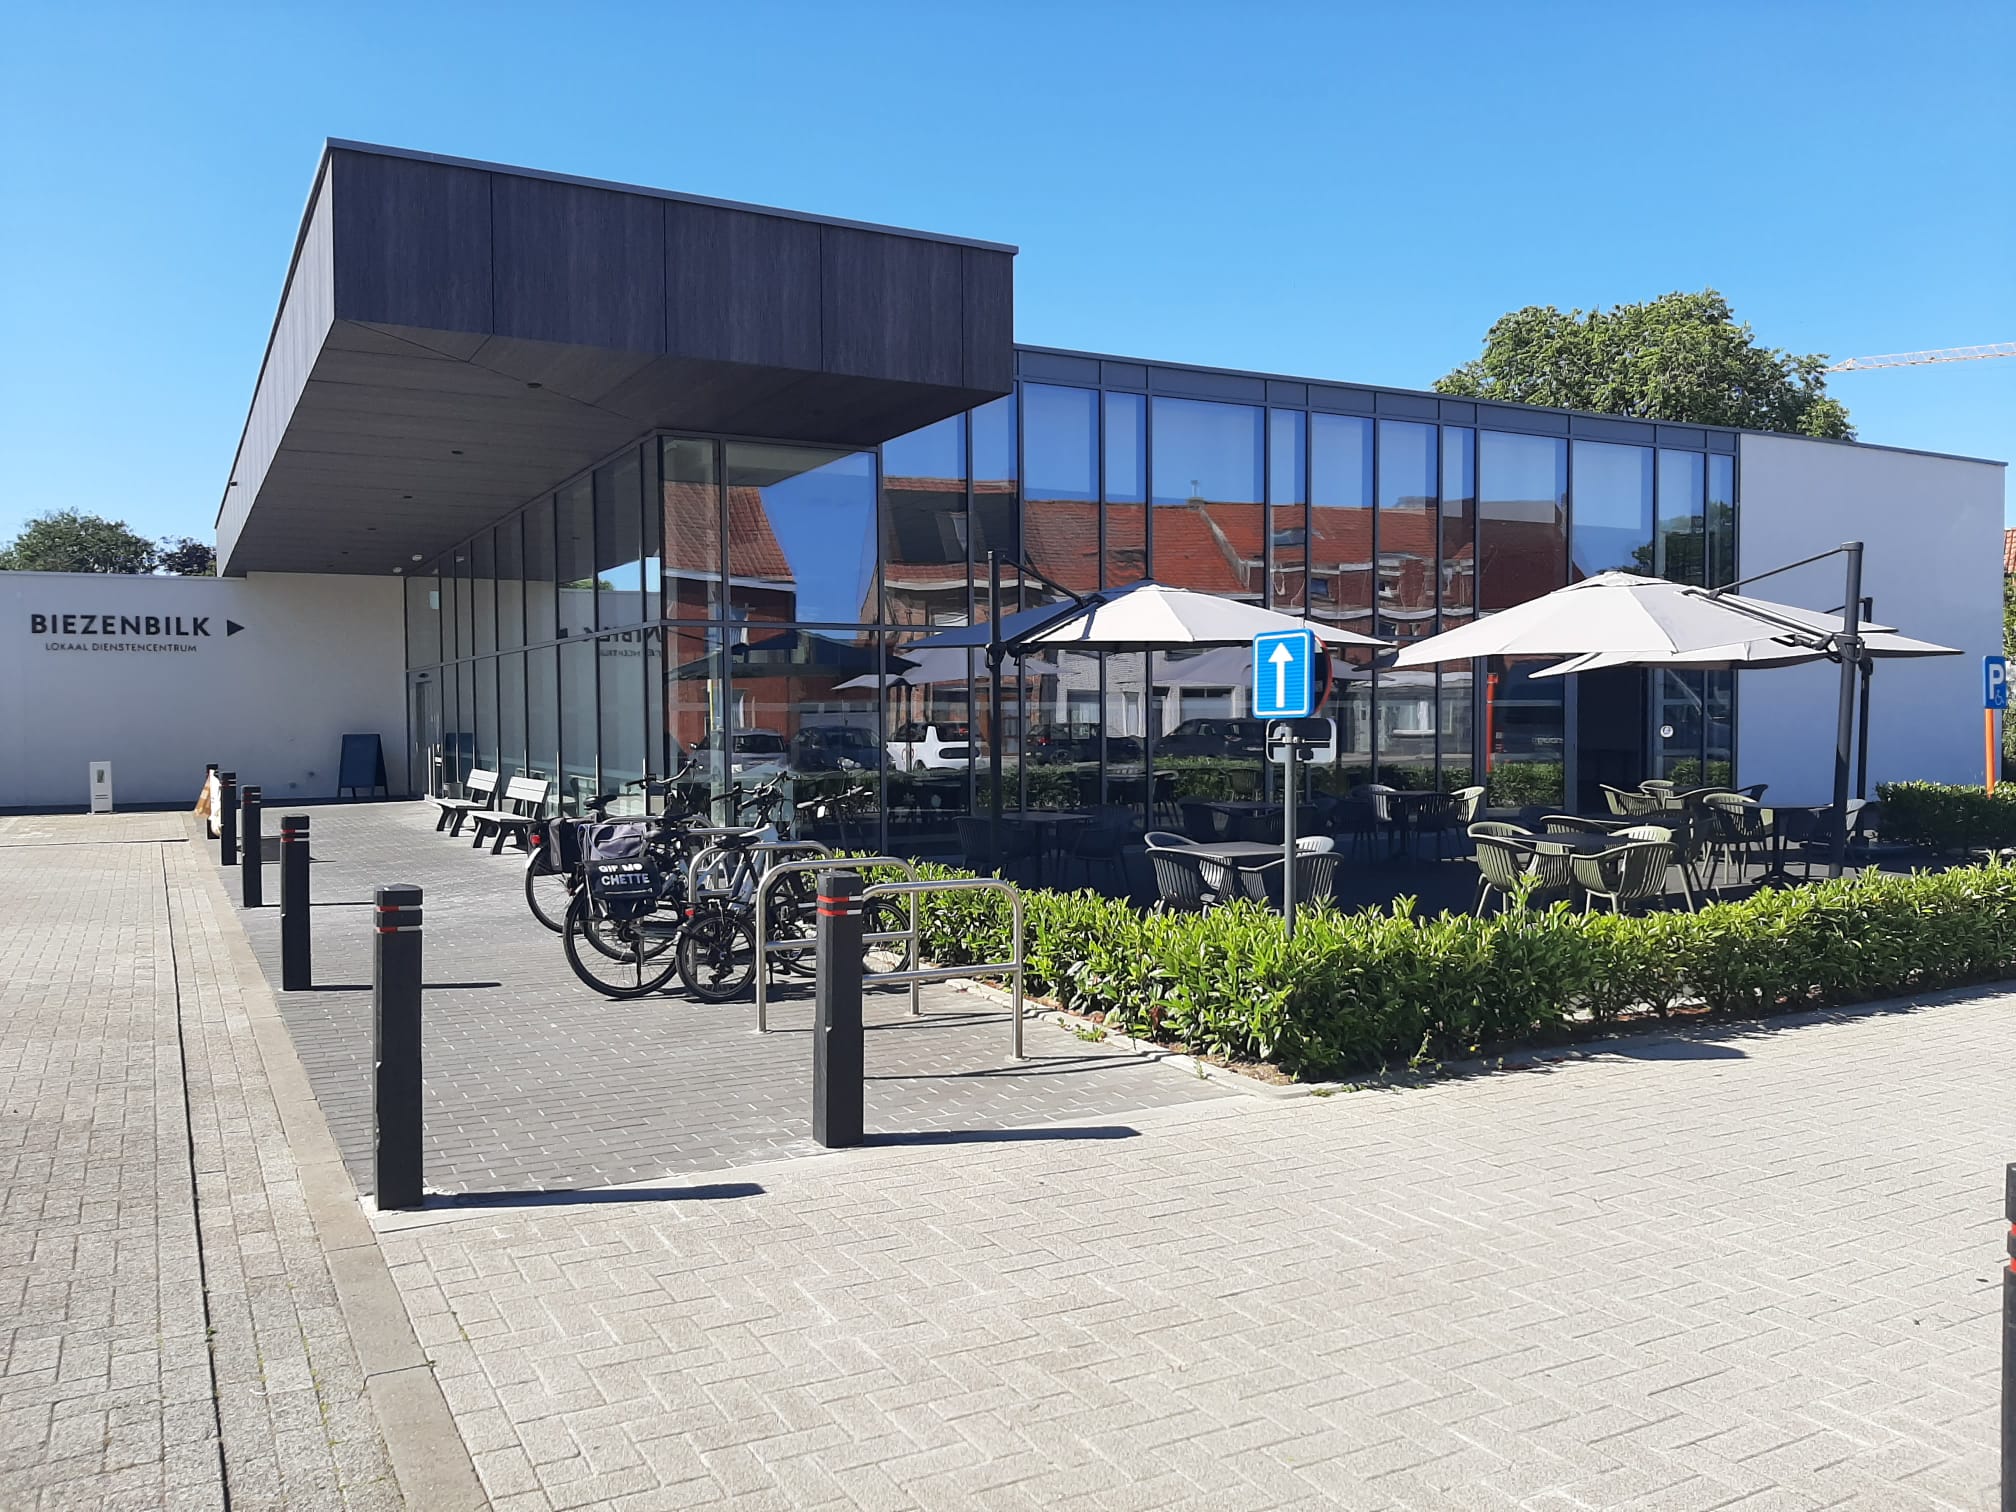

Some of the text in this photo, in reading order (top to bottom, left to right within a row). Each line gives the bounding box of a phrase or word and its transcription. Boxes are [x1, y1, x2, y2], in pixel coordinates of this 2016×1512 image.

[31, 614, 211, 637] BIEZENBILK
[45, 642, 198, 653] LOKAAL DIENSTENCENTRUM
[1989, 663, 2004, 699] P
[601, 873, 650, 886] CHETTE
